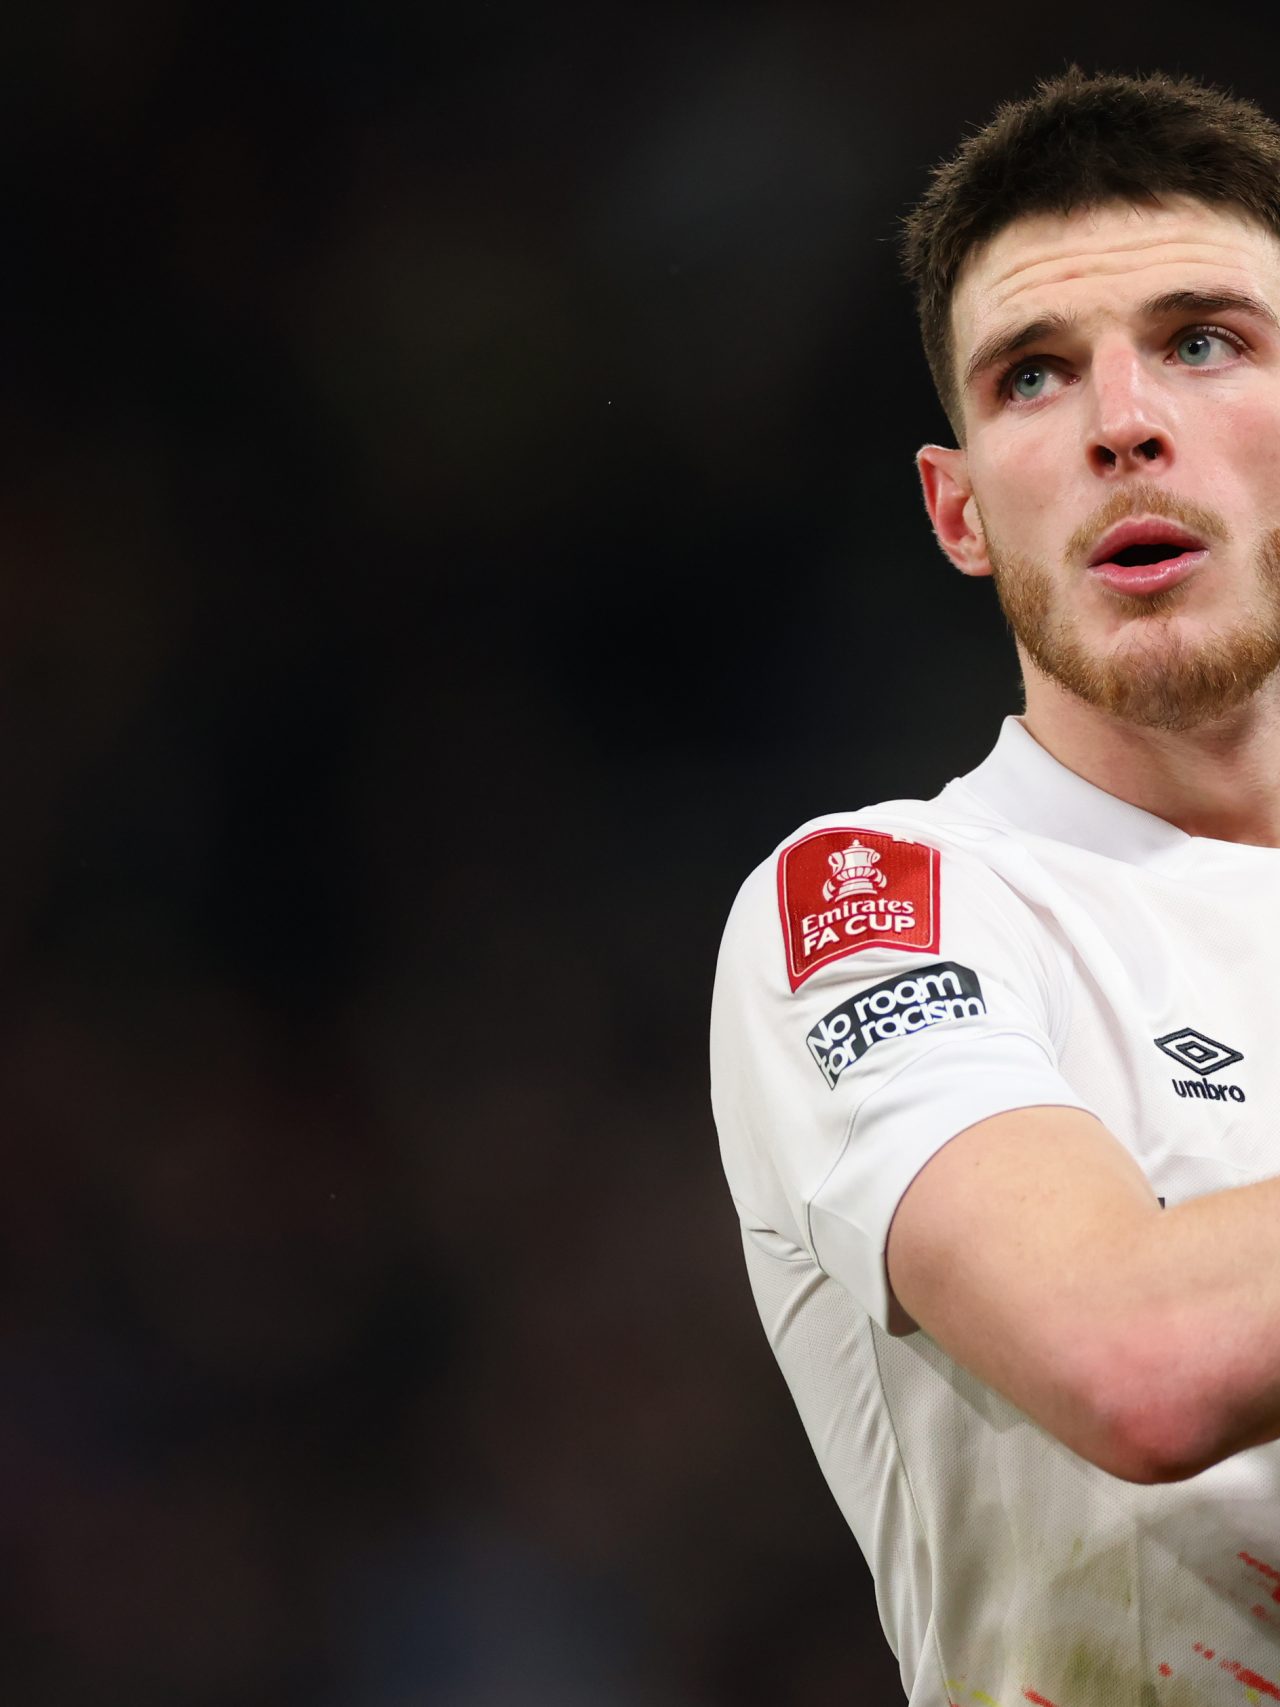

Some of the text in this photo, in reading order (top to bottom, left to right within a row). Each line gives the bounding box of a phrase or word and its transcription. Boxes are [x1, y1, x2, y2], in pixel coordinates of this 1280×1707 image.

[801, 898, 914, 935] Emirates
[803, 914, 916, 957] FA CUP
[807, 970, 962, 1065] No room
[820, 996, 987, 1088] for racism
[1172, 1077, 1246, 1103] umbro
